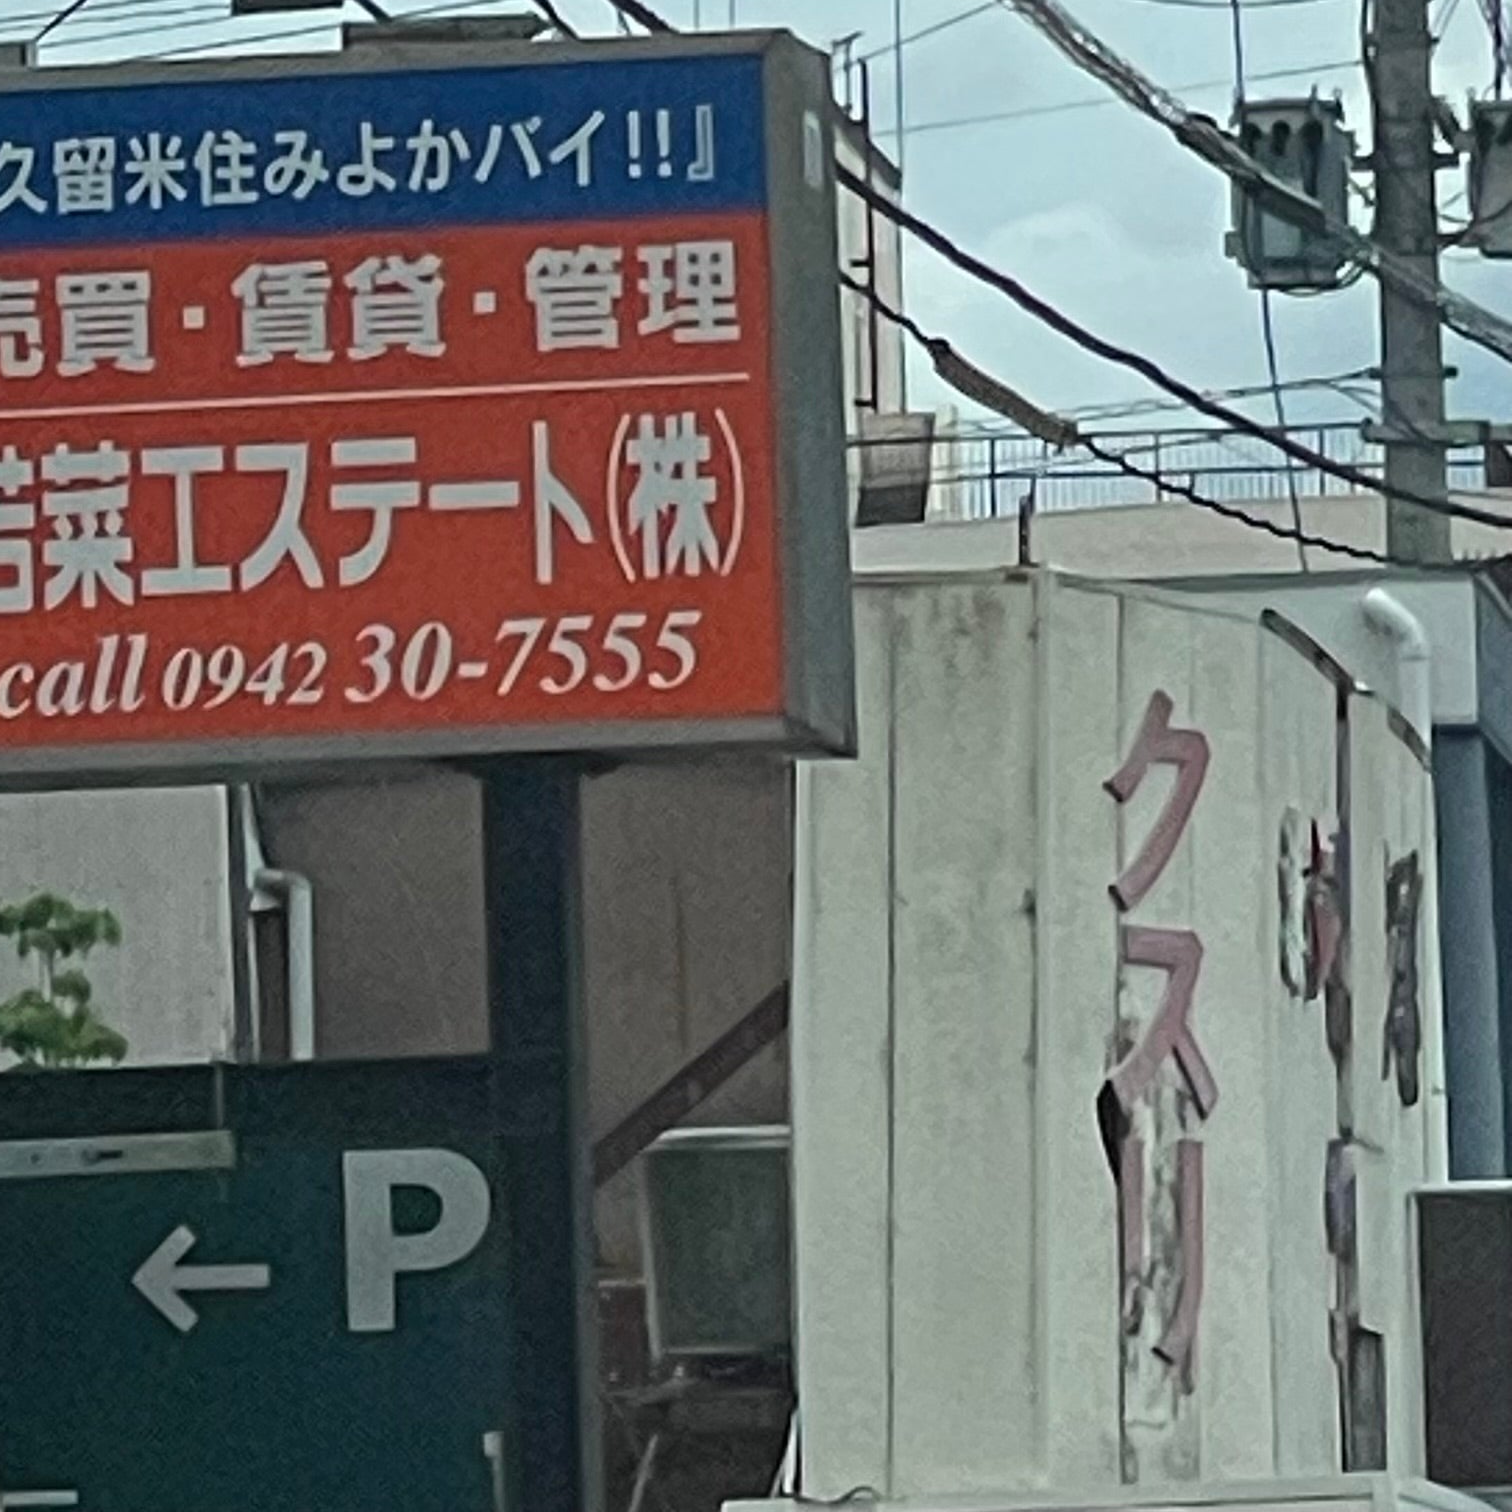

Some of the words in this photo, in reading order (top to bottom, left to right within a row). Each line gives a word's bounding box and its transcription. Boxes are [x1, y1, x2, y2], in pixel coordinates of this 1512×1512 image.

[162, 643, 327, 711] 0942
[344, 609, 702, 705] 30-7555
[342, 1147, 490, 1332] P
